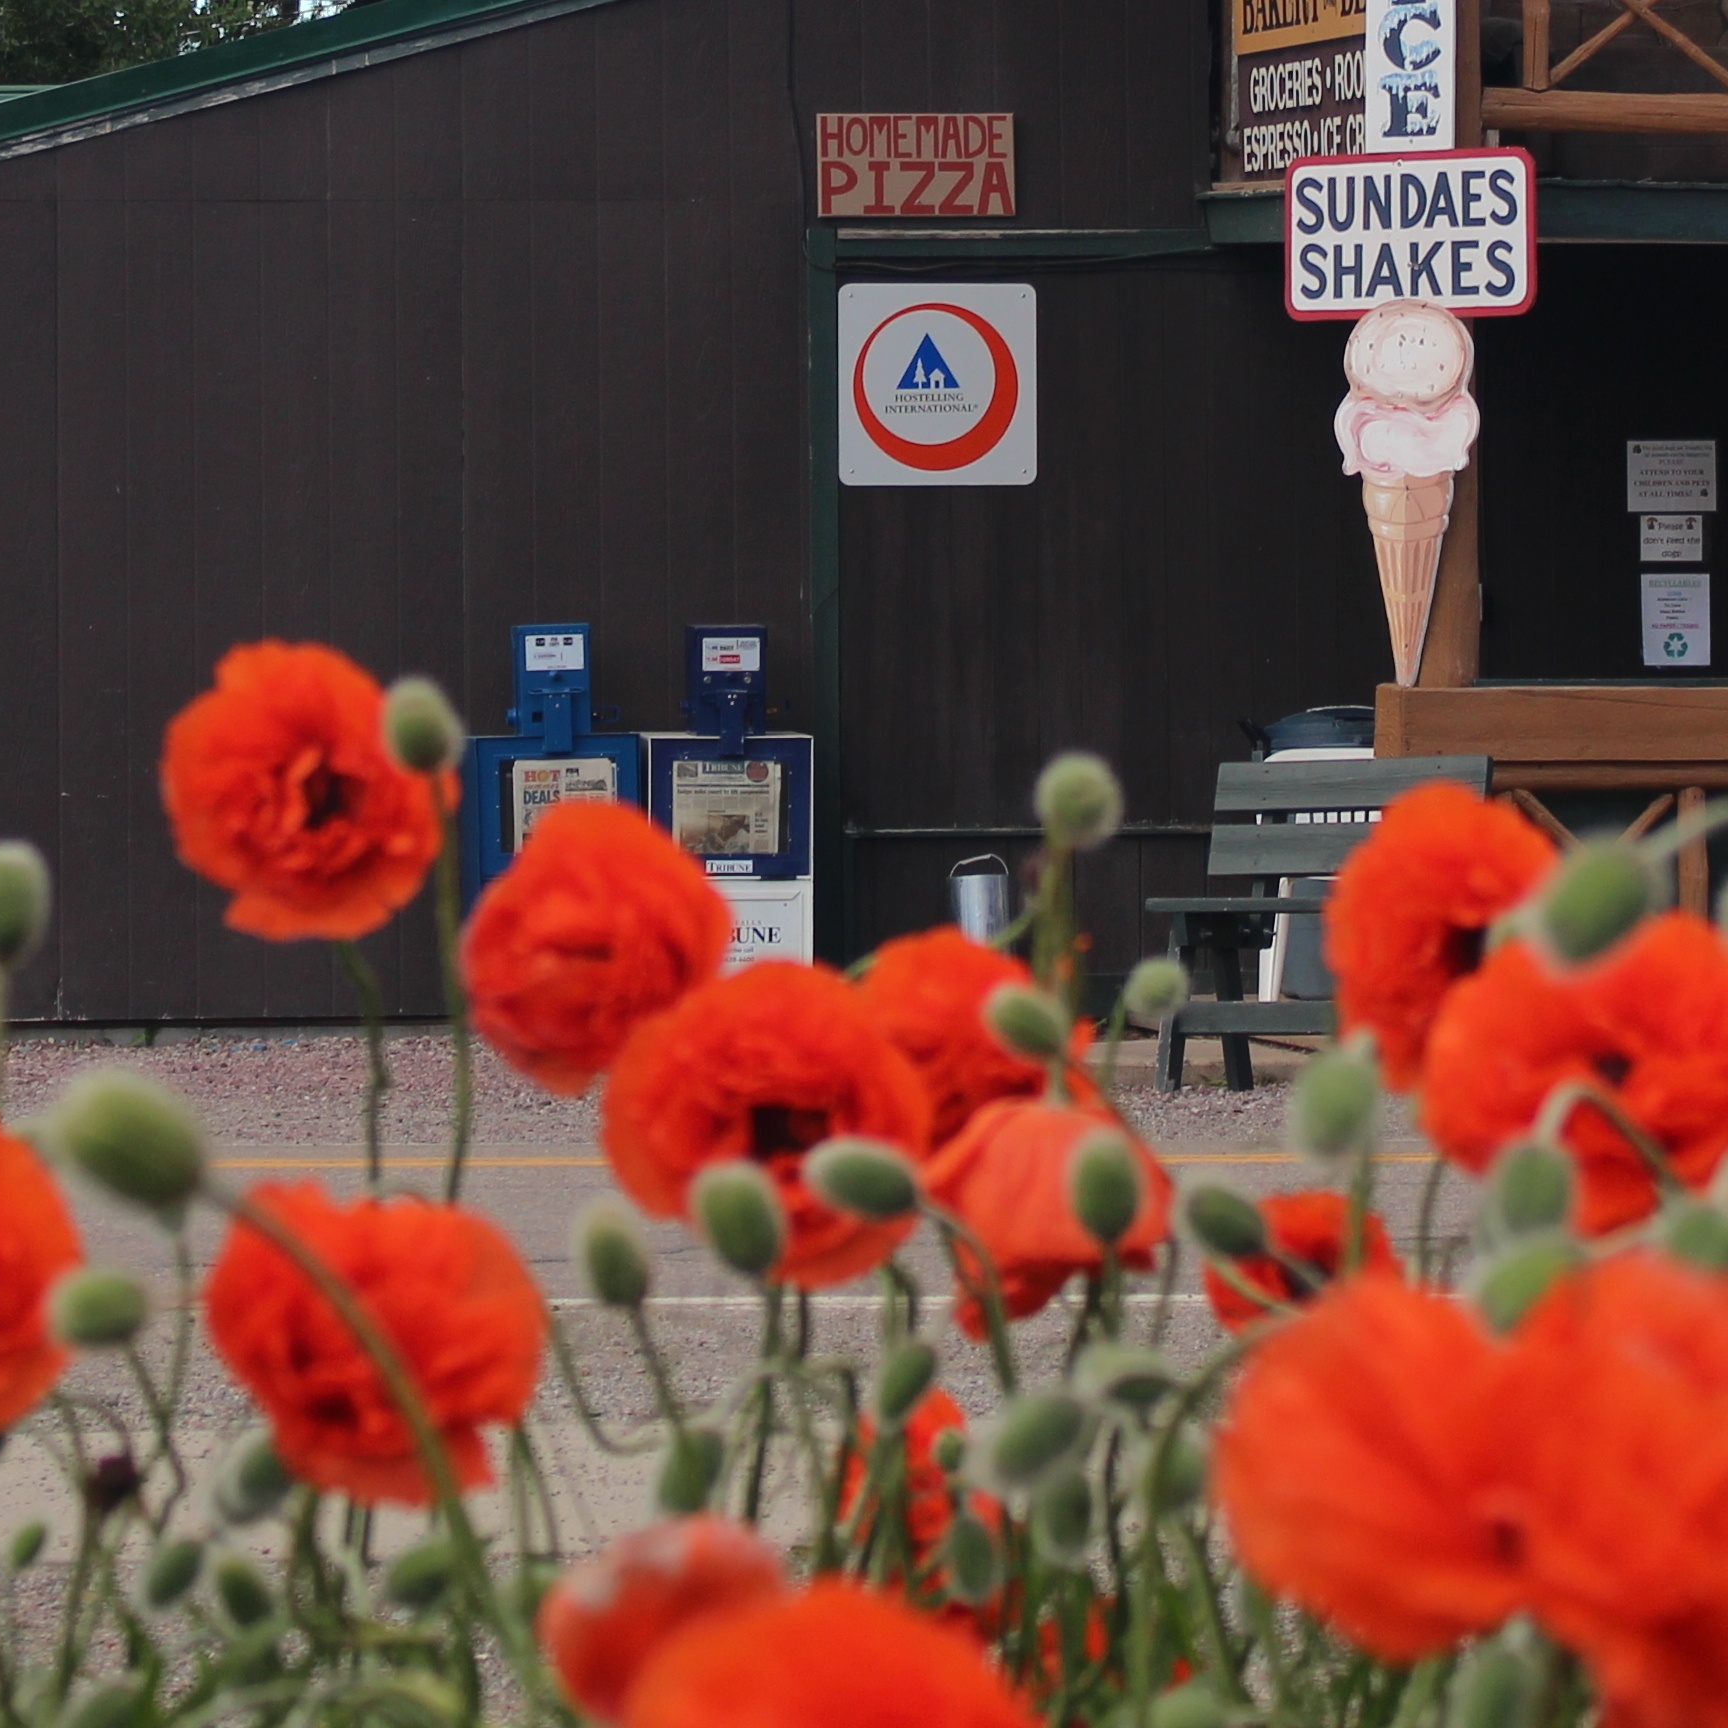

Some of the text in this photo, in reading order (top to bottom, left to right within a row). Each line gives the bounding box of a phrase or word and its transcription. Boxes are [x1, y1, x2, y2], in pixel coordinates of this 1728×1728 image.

[1250, 50, 1366, 114] GROCERIES ROO
[820, 115, 1008, 160] HOMEMADE
[1243, 119, 1312, 173] ESPRESSO
[1345, 113, 1366, 156] CR
[821, 161, 1014, 215] PIZZA
[1296, 169, 1519, 235] SUNDAES
[1299, 240, 1516, 300] SHAKES
[895, 393, 964, 403] HOSTELLING
[524, 770, 560, 783] HOT
[524, 790, 561, 805] DEALS
[710, 862, 752, 872] TRIBUNE
[730, 927, 782, 944] BUNE
